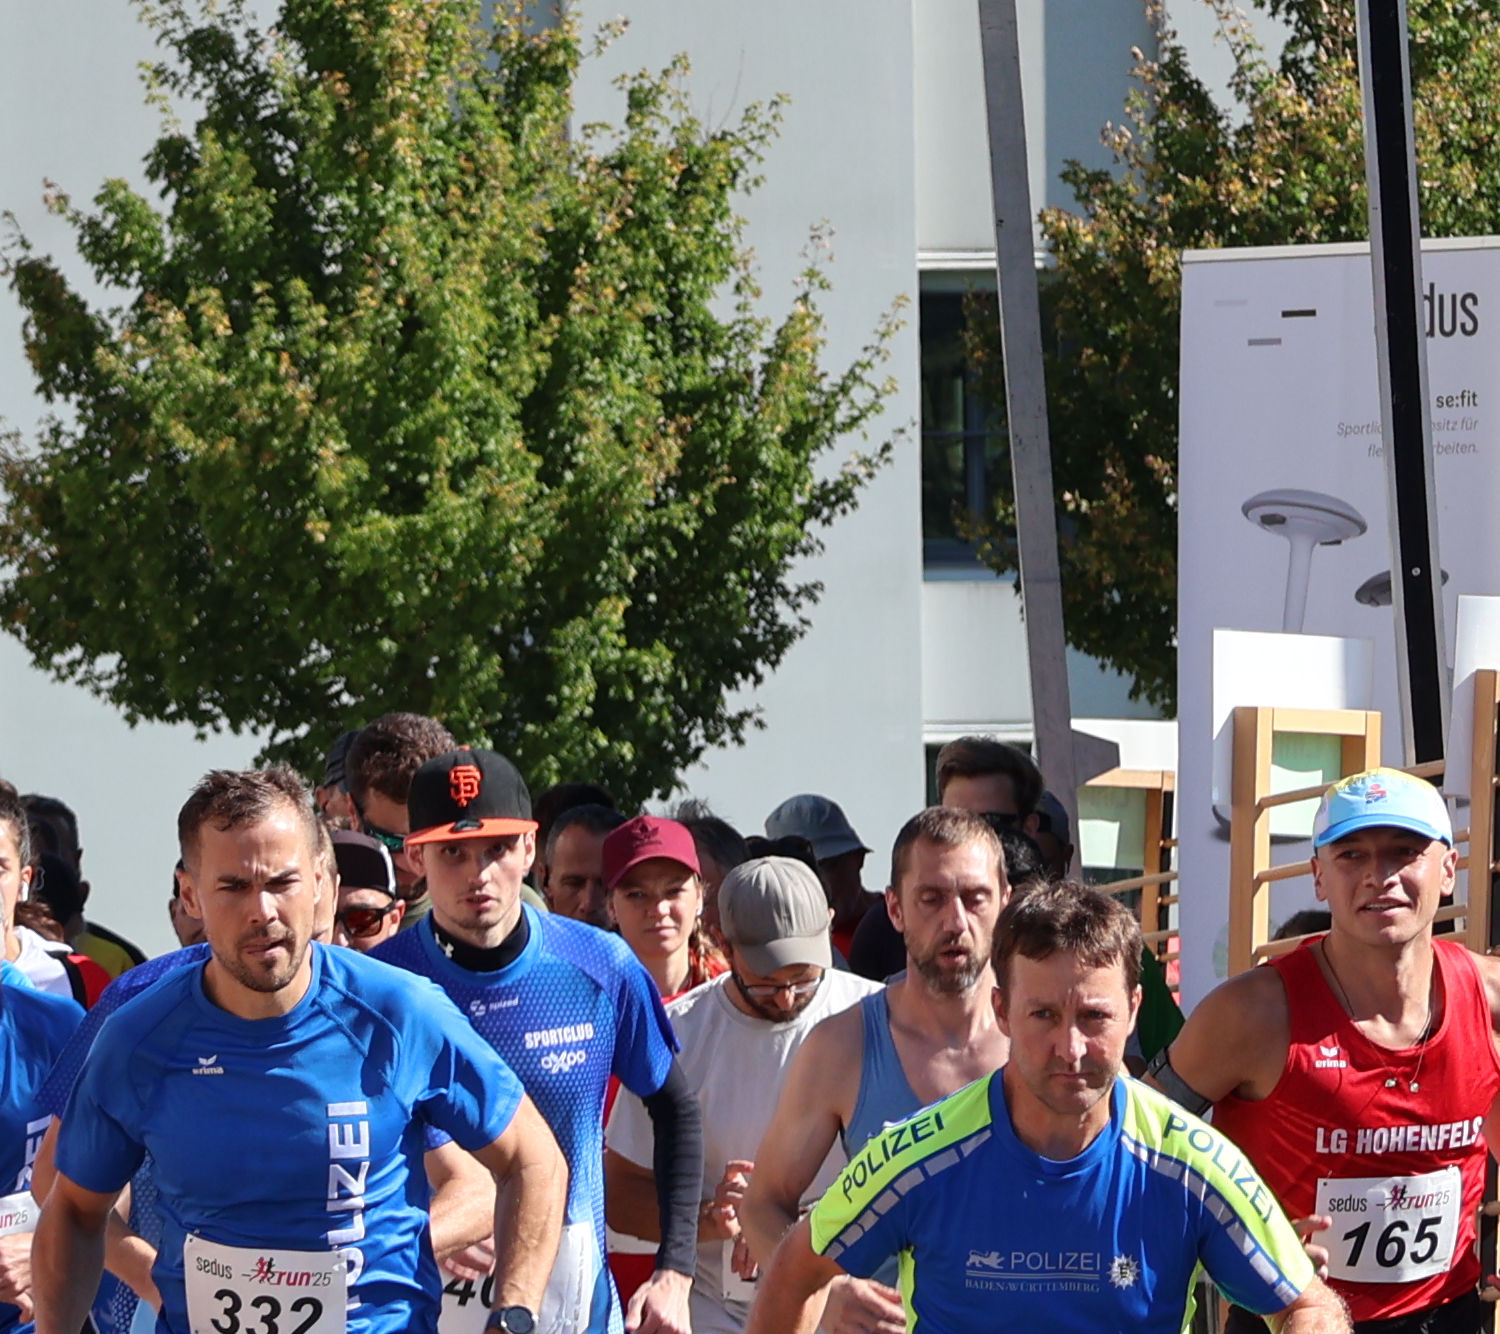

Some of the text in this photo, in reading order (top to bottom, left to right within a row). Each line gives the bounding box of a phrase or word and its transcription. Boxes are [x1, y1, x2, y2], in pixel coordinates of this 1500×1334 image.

[1423, 282, 1479, 338] dus
[1436, 389, 1478, 409] se:fit
[1316, 1116, 1485, 1154] LG HOHENFELS
[842, 1111, 944, 1203] POLIZEI
[1162, 1112, 1275, 1225] POLIZEI
[1328, 1195, 1367, 1212] sedus
[1342, 1216, 1443, 1269] 165
[196, 1256, 233, 1280] sedus
[1011, 1252, 1100, 1271] POLIZEI
[965, 1279, 1100, 1294] BADEN-WÜRTTEMBERG
